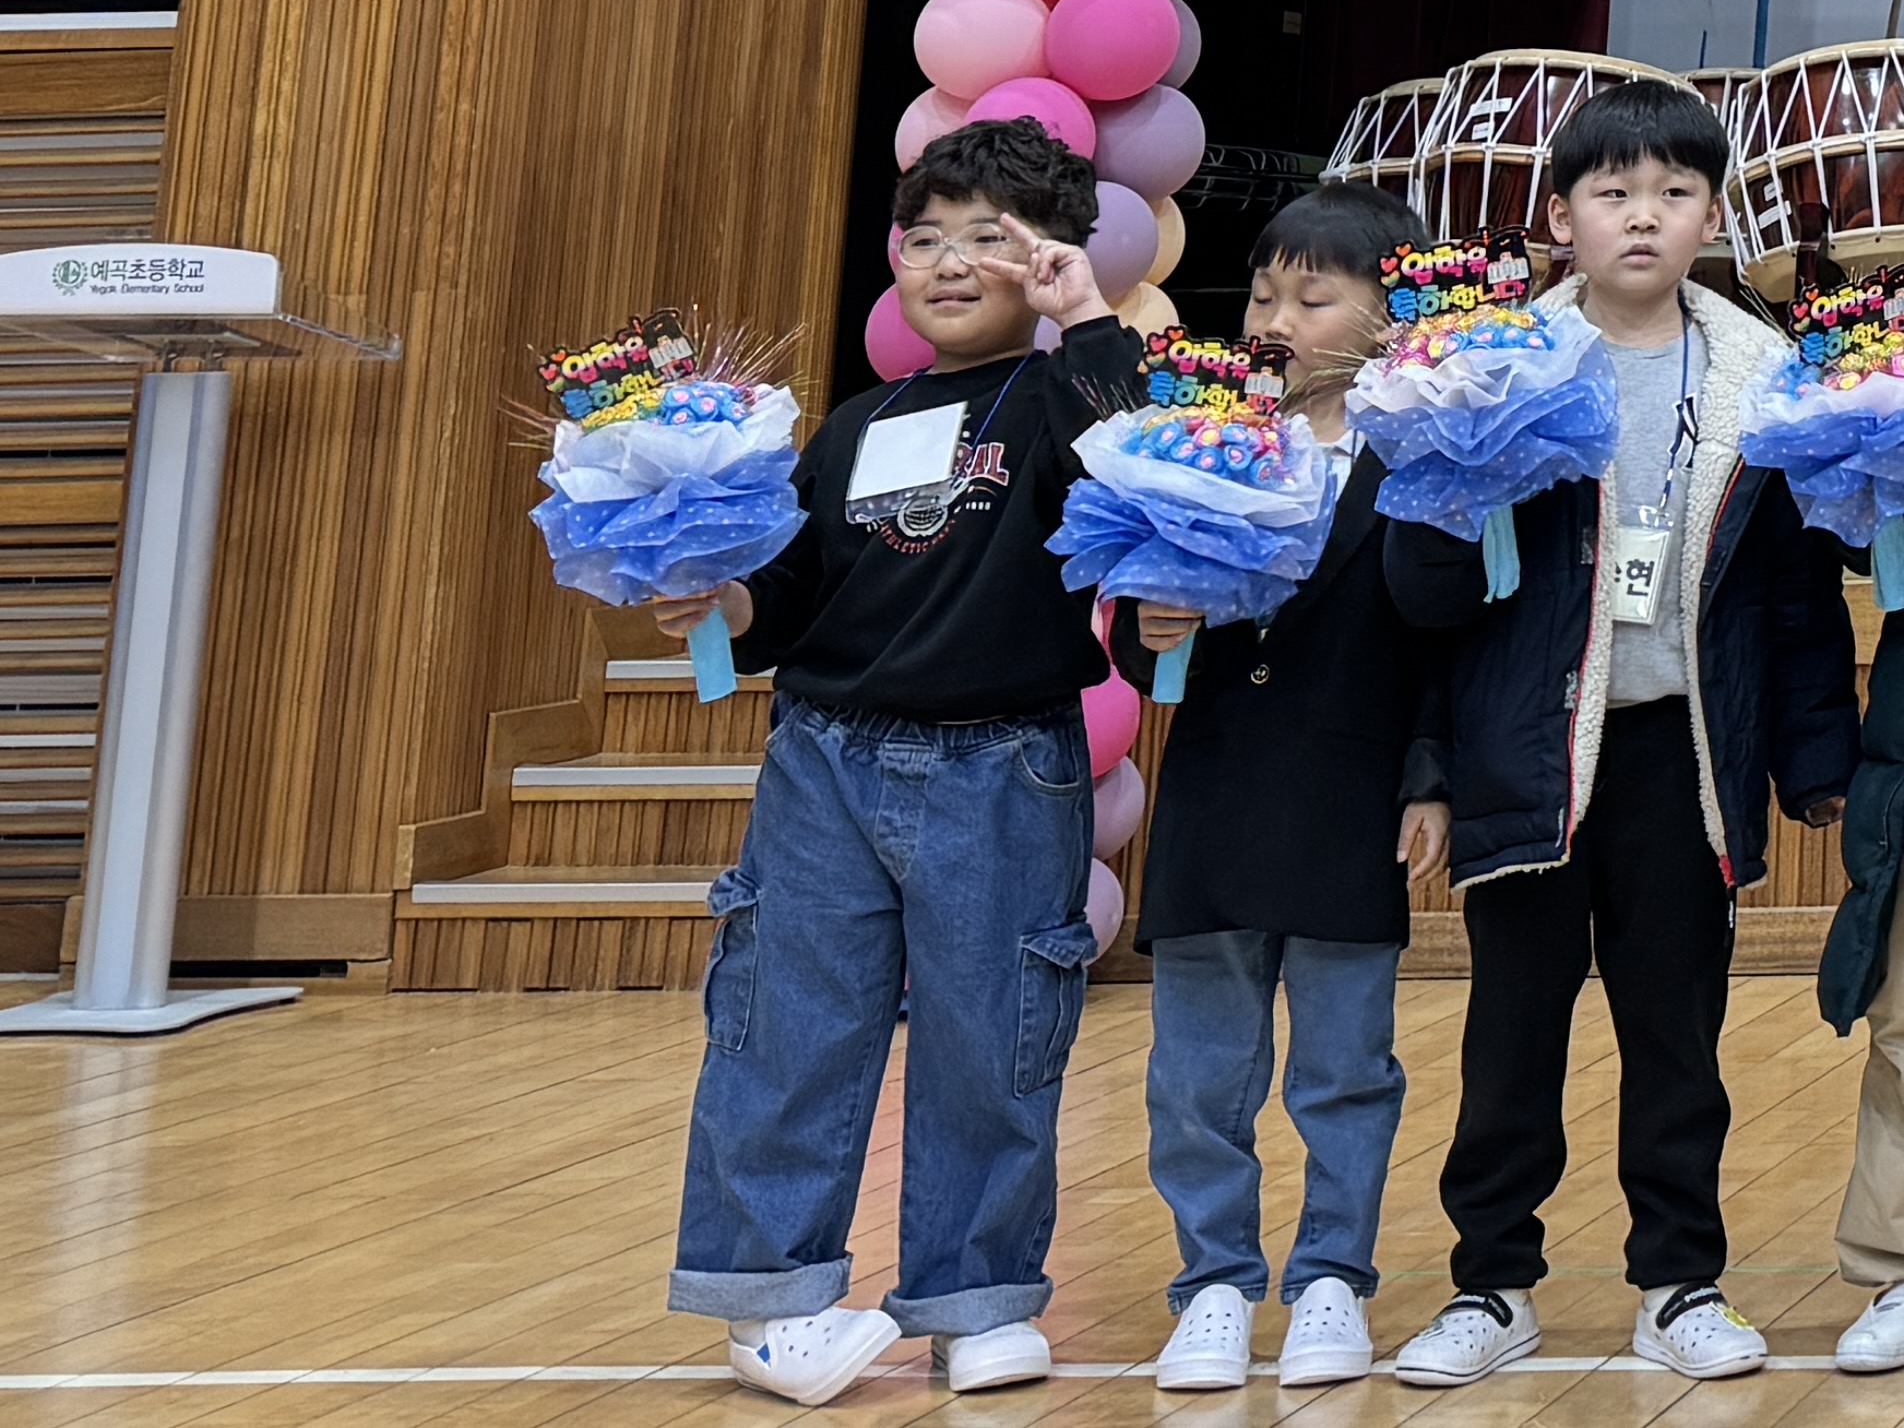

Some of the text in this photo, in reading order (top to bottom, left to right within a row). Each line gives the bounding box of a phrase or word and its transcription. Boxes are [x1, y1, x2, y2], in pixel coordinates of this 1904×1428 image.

[90, 258, 205, 282] 예곡초등학교
[121, 283, 171, 295] Elementary
[174, 283, 205, 293] School
